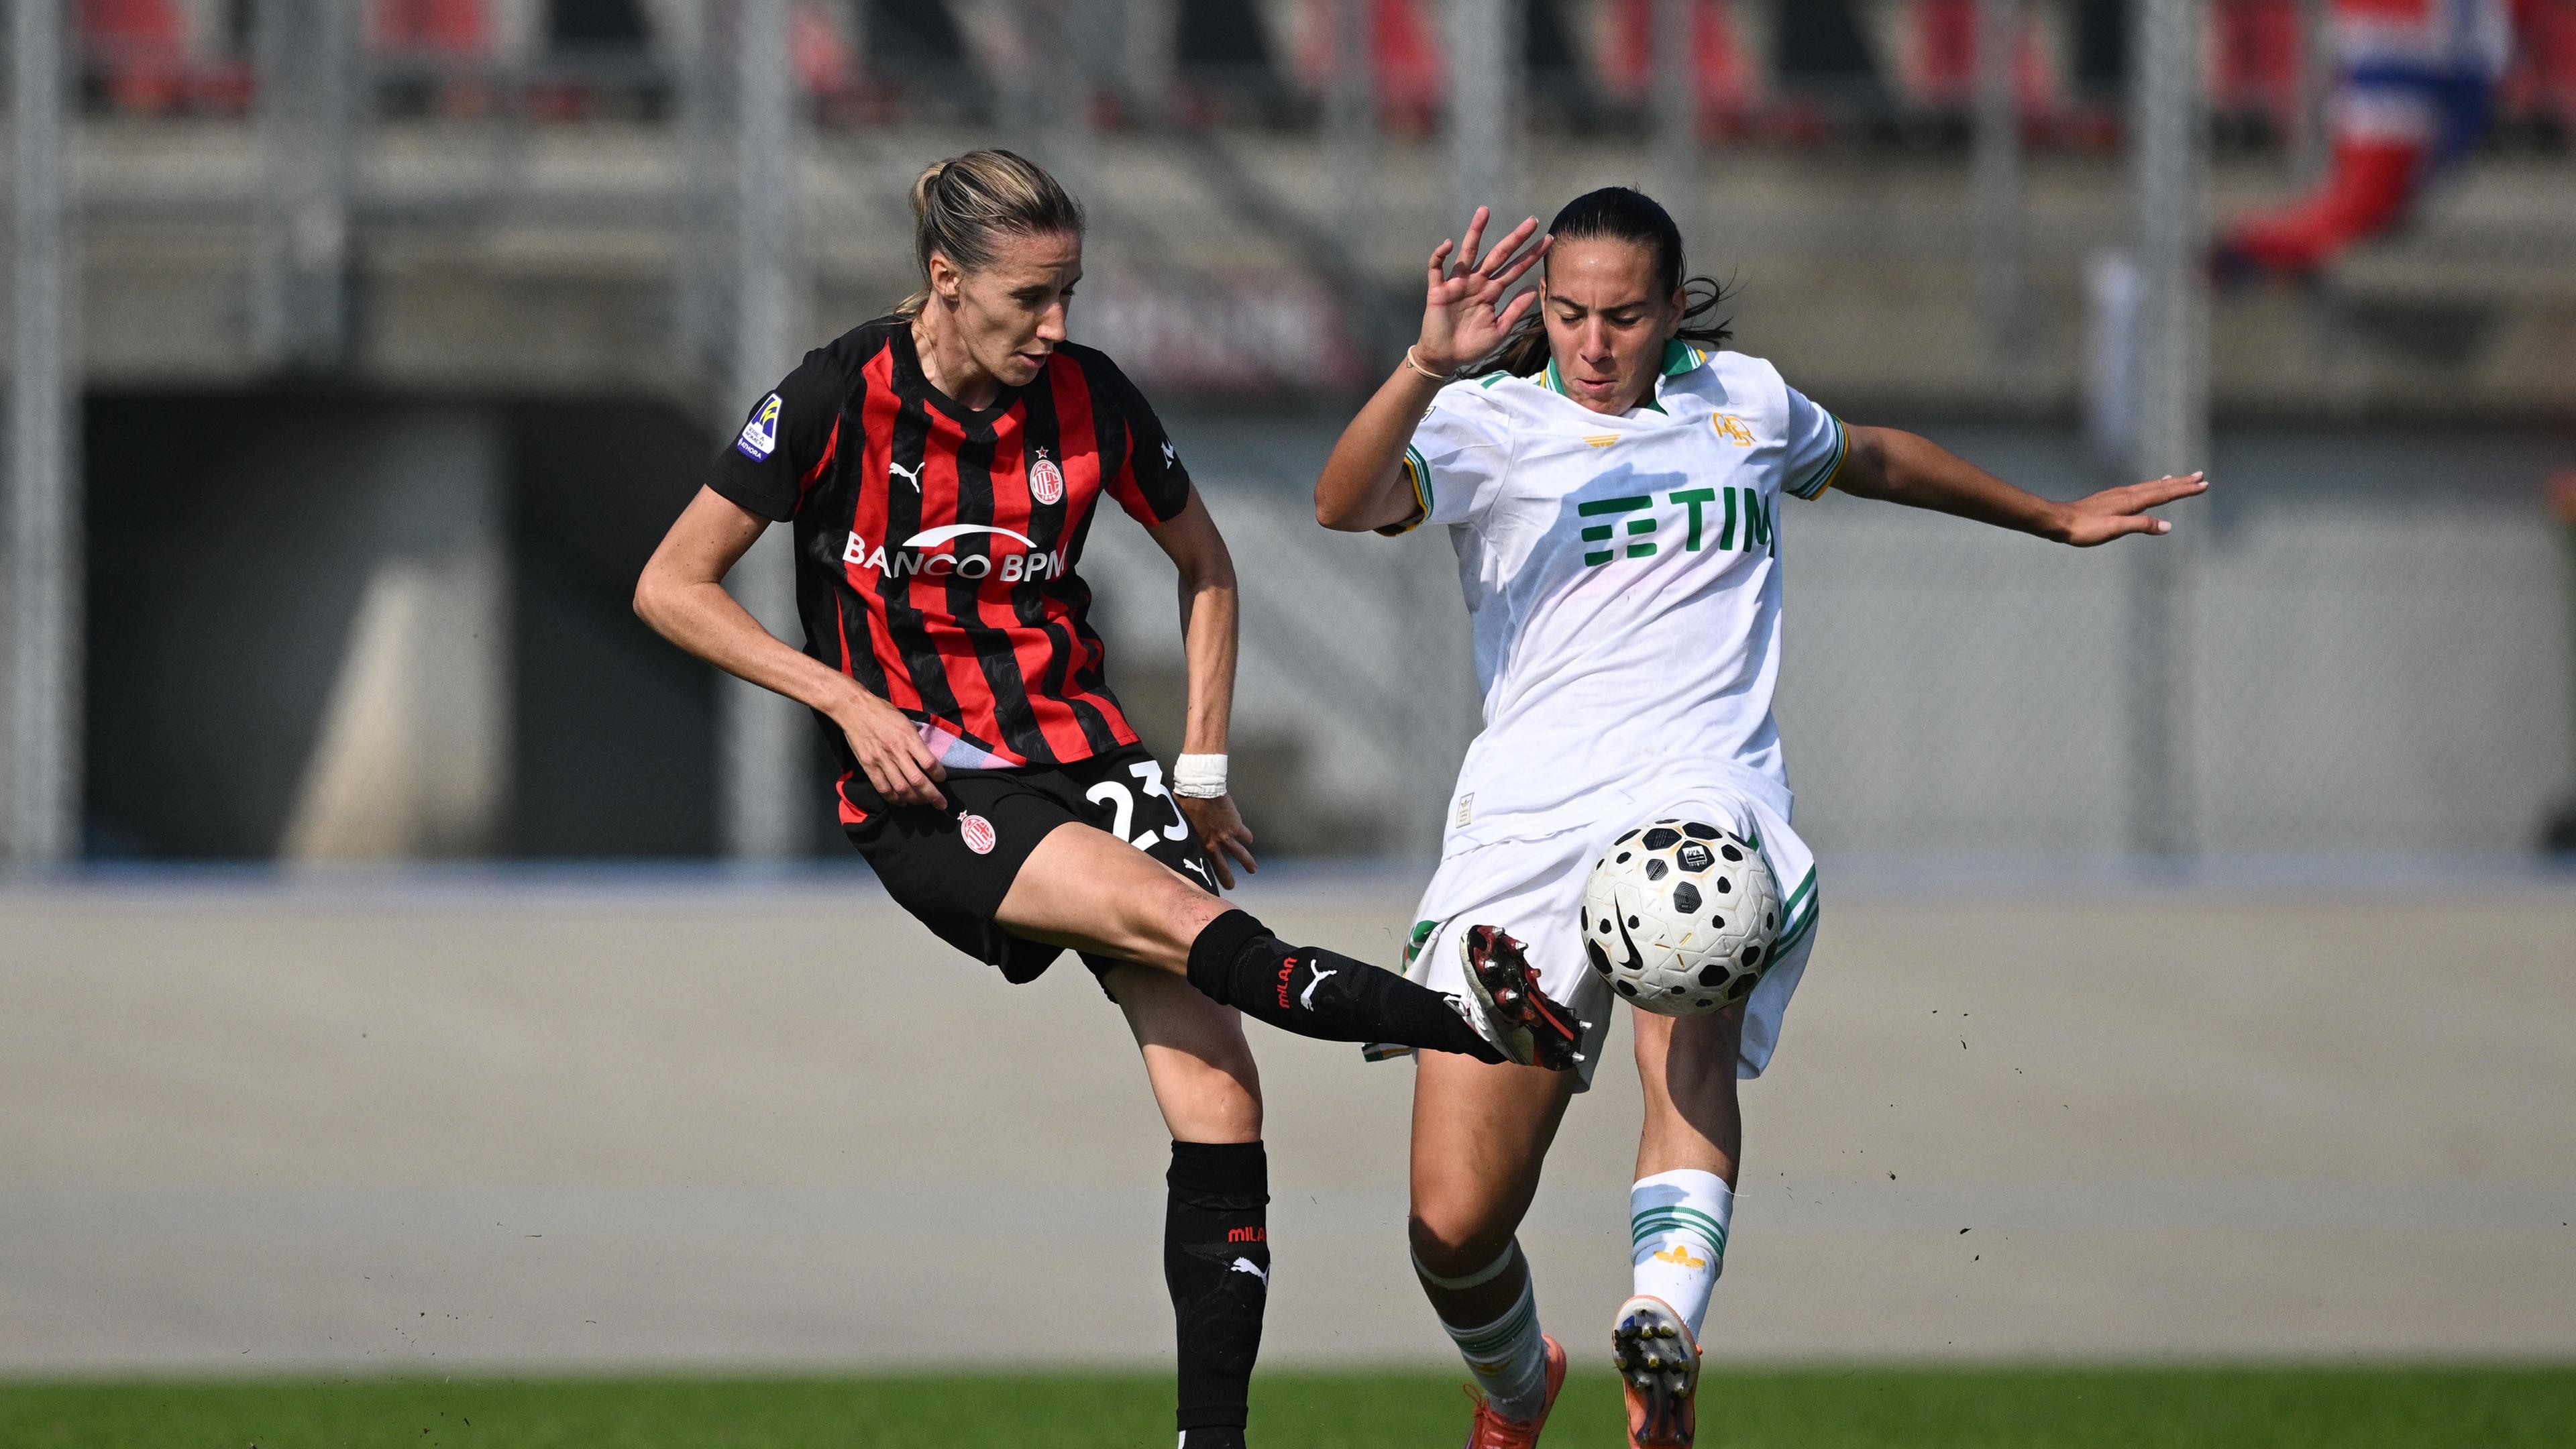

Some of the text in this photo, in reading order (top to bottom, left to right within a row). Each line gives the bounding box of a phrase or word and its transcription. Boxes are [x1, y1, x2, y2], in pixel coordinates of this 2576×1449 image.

[741, 441, 762, 459] ATHORA
[745, 431, 764, 447] WOMEN
[1036, 464, 1055, 474] ACM
[1668, 487, 1775, 558] TIM
[843, 531, 1068, 582] BANCO BPM
[1085, 760, 1188, 851] 23
